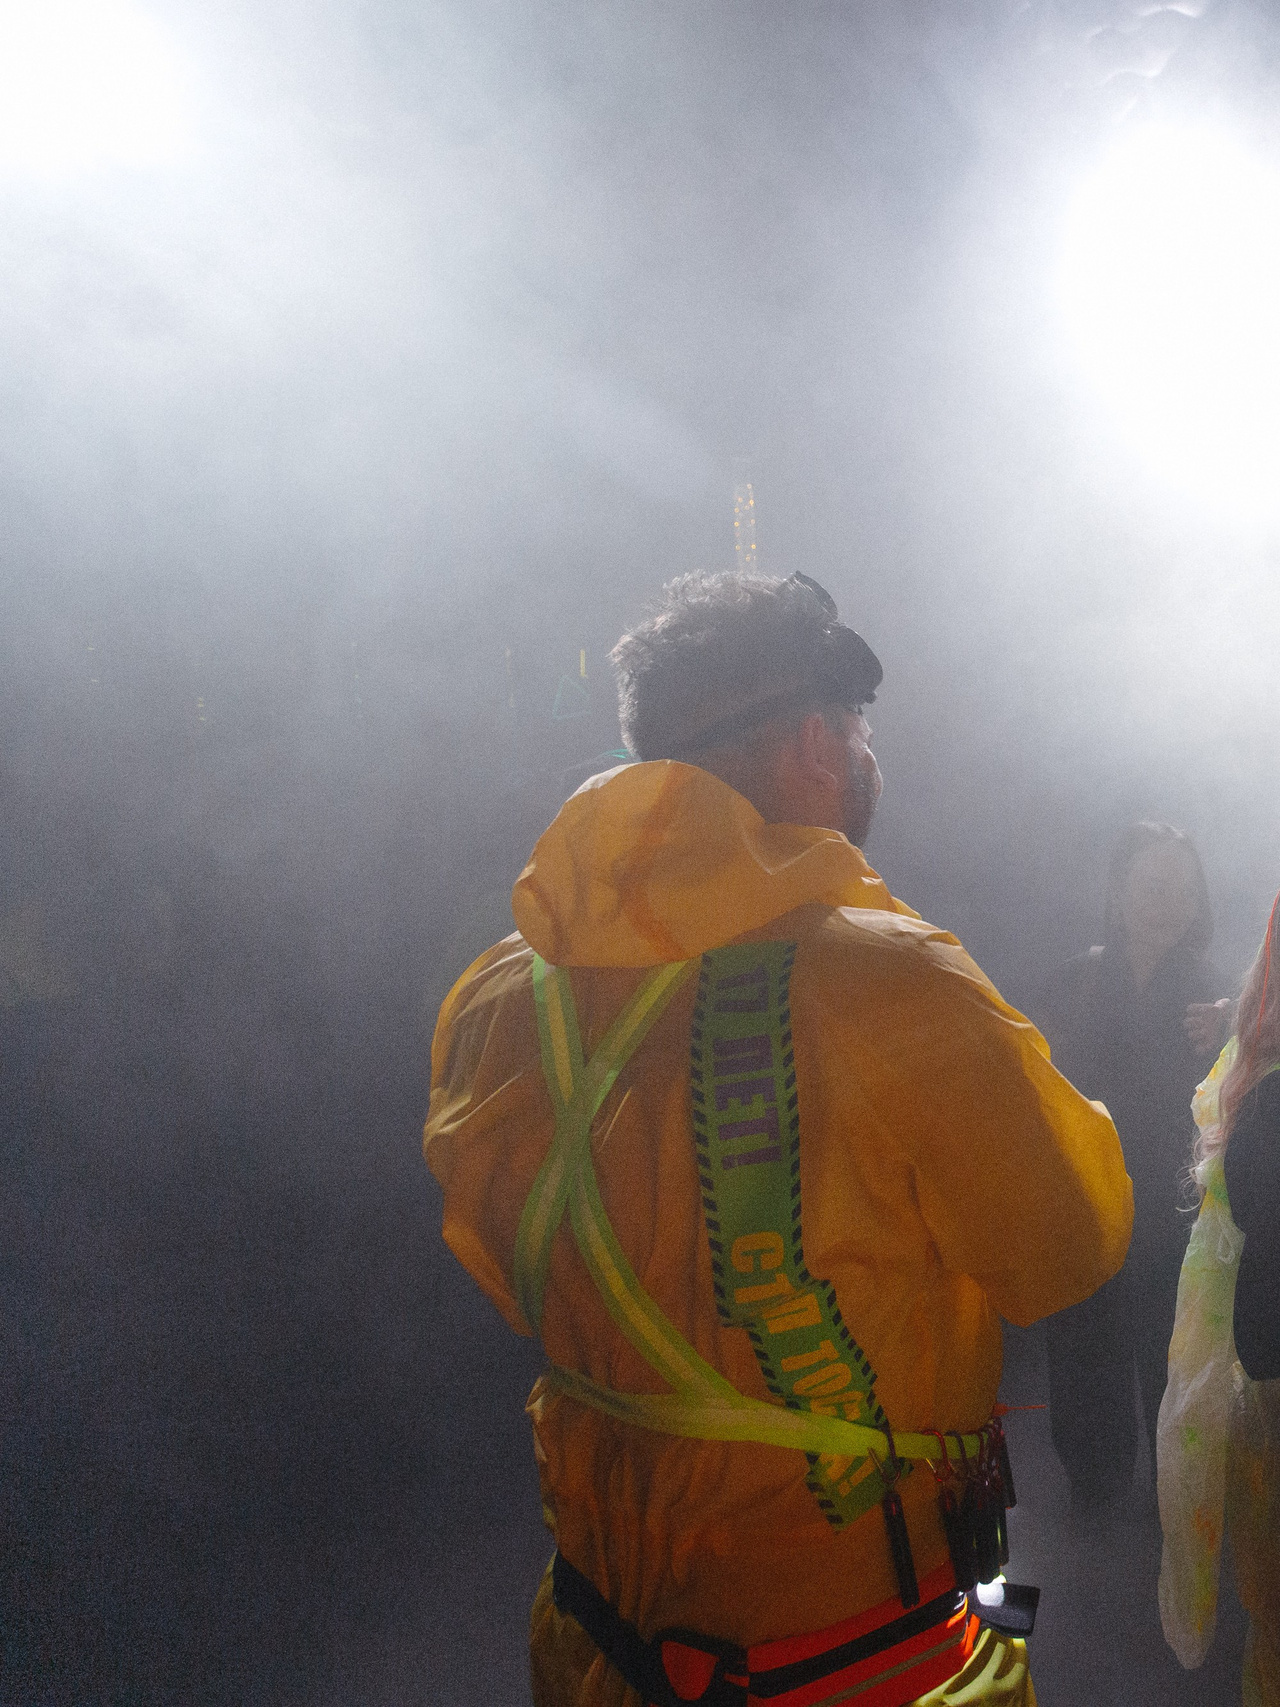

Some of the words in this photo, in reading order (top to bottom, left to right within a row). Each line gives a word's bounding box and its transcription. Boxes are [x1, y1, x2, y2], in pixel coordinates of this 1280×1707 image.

[713, 965, 770, 1013] 17
[713, 1033, 782, 1171] ЛЕТ!
[731, 1232, 823, 1334] СТП
